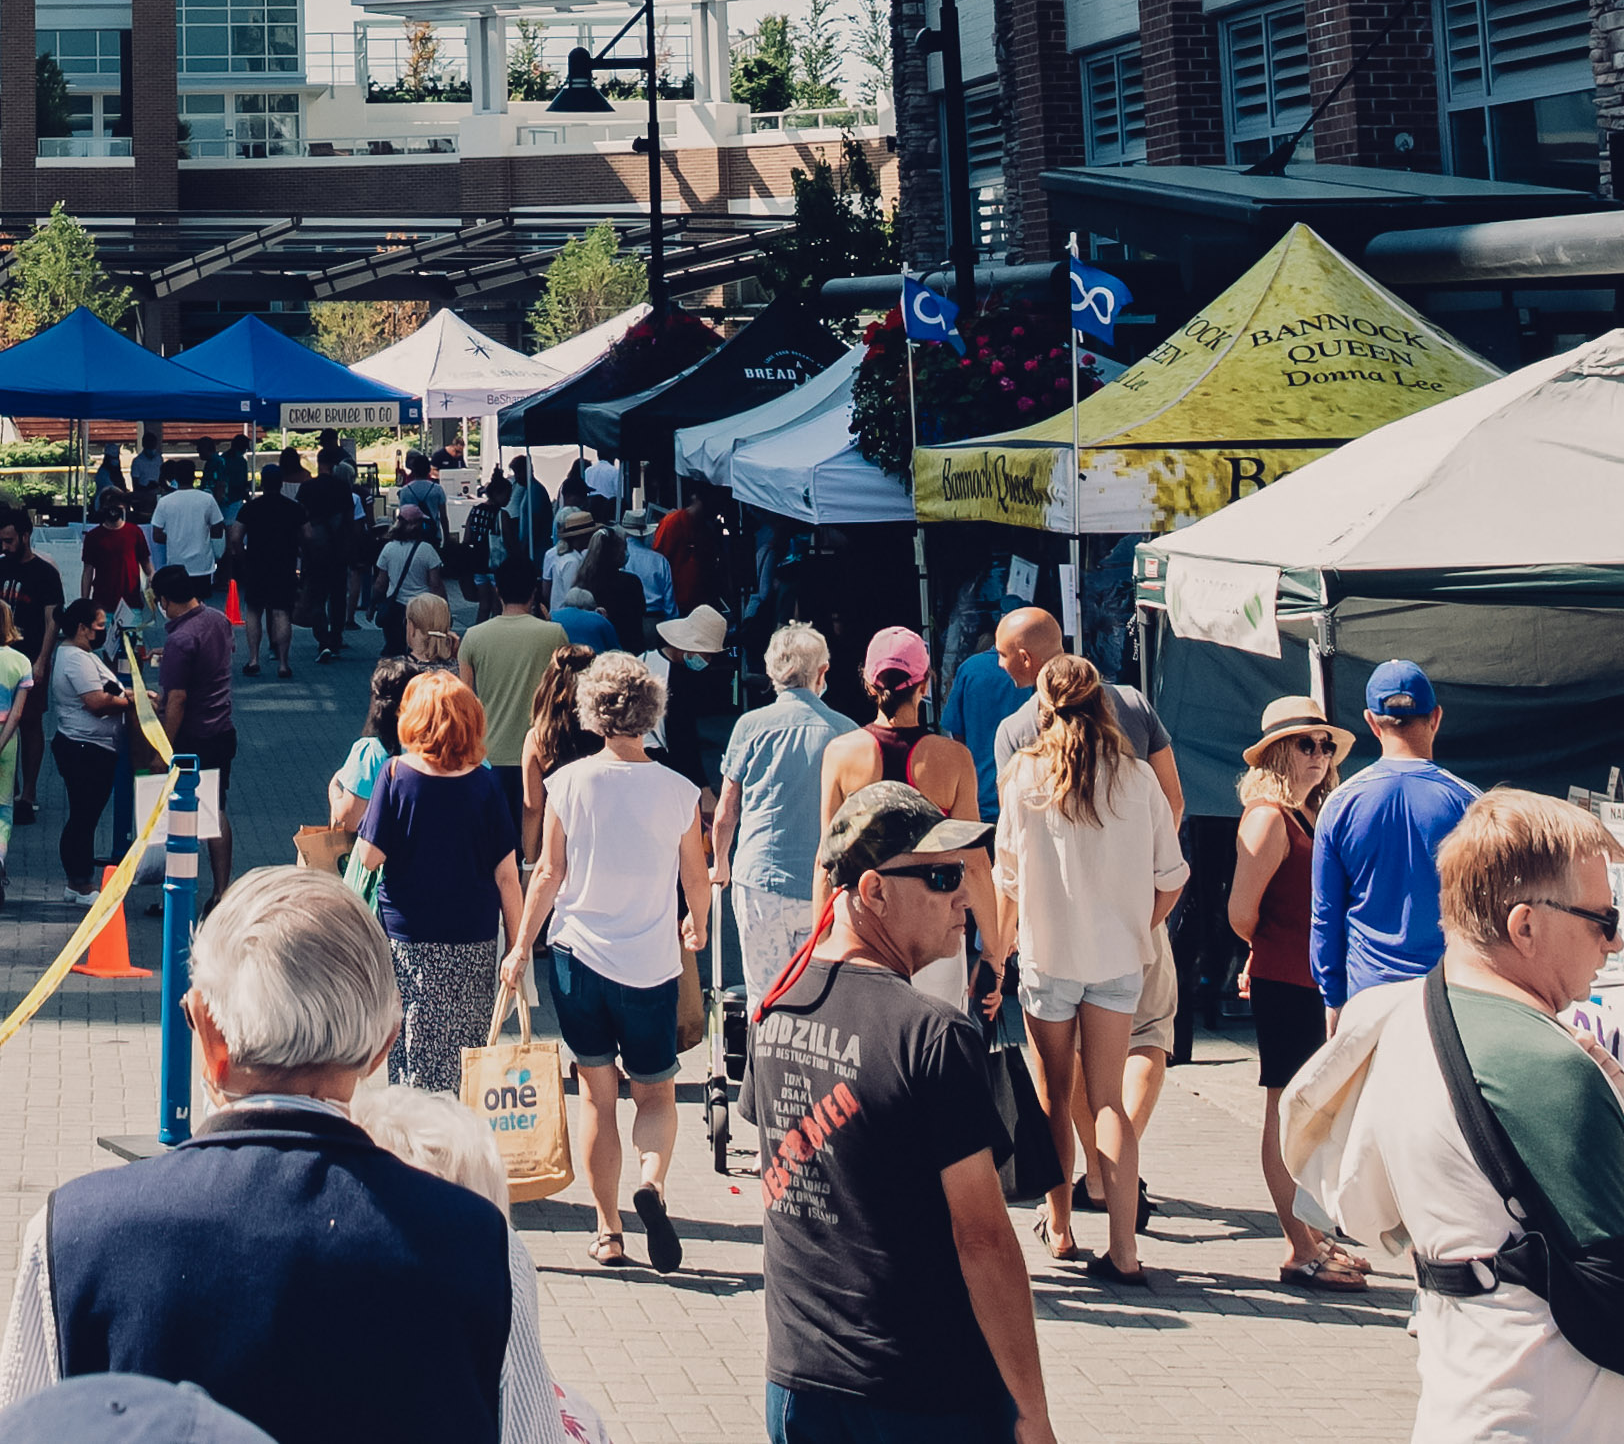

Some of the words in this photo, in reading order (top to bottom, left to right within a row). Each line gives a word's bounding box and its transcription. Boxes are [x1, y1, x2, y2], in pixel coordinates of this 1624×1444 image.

[1251, 313, 1430, 351] BANNOCK
[1288, 339, 1414, 367] QUEEN
[744, 367, 797, 380] BREAD
[1281, 369, 1384, 388] Donna
[1393, 370, 1445, 393] Lee
[363, 407, 376, 422] TO
[378, 406, 393, 422] GO
[942, 451, 993, 501] Bannock
[776, 1046, 829, 1071] DESTRUCTION
[833, 1062, 858, 1081] TOUR
[484, 1085, 537, 1111] one
